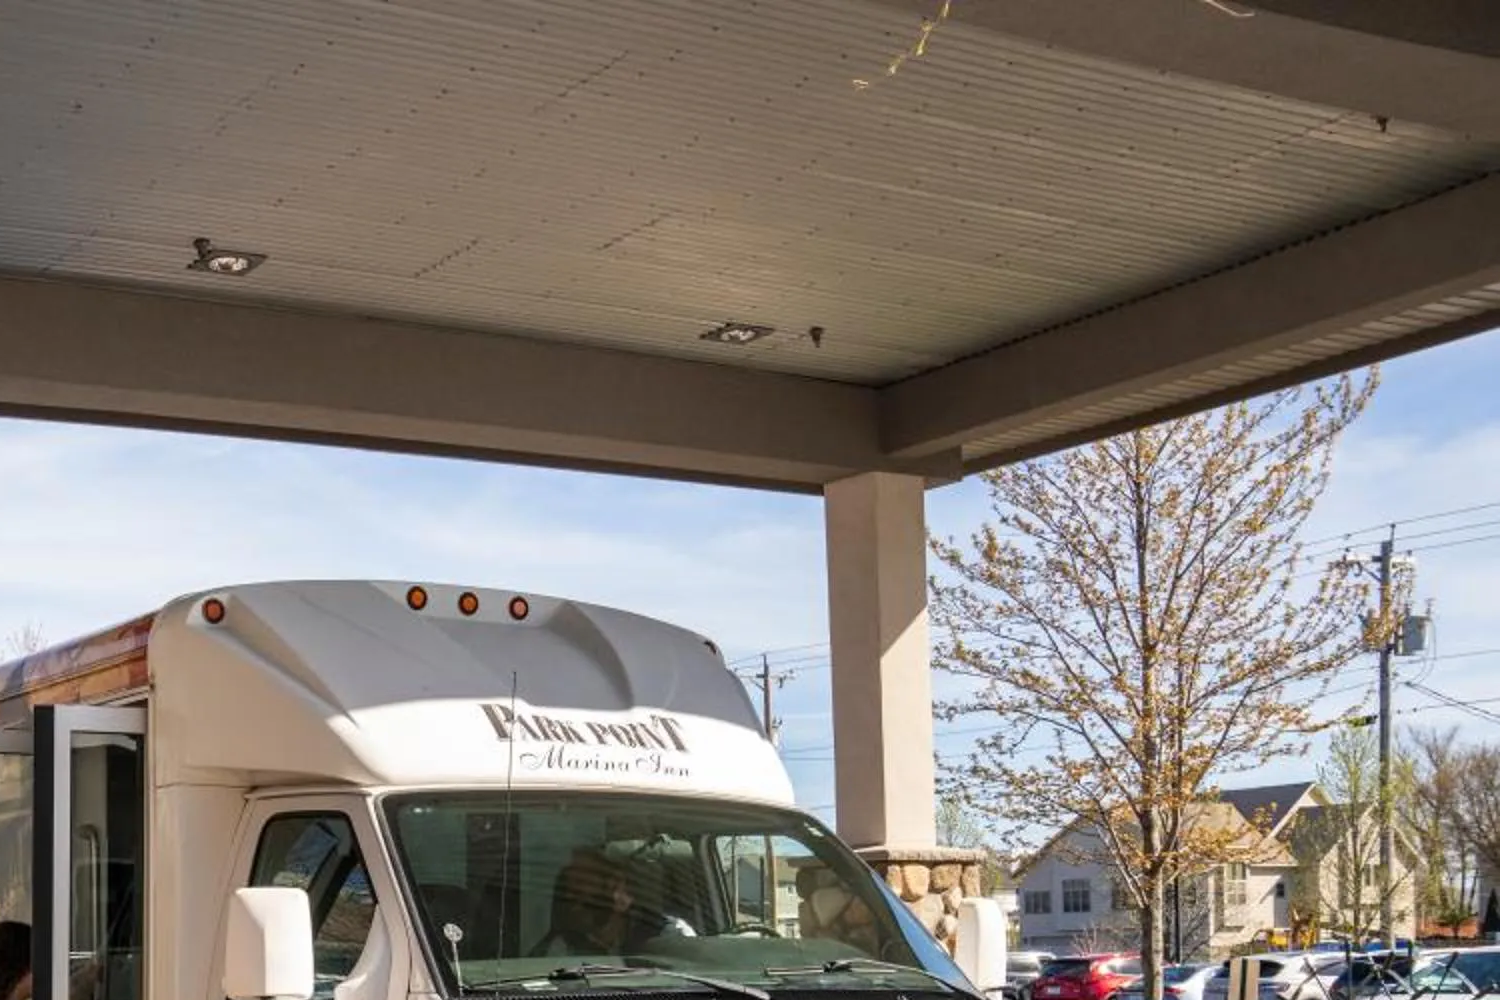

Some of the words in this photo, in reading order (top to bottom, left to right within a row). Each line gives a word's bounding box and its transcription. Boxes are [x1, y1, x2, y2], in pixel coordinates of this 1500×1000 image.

[481, 703, 586, 743] PARK
[585, 714, 689, 753] POINT
[519, 744, 630, 771] Marina
[635, 753, 691, 777] Inn
